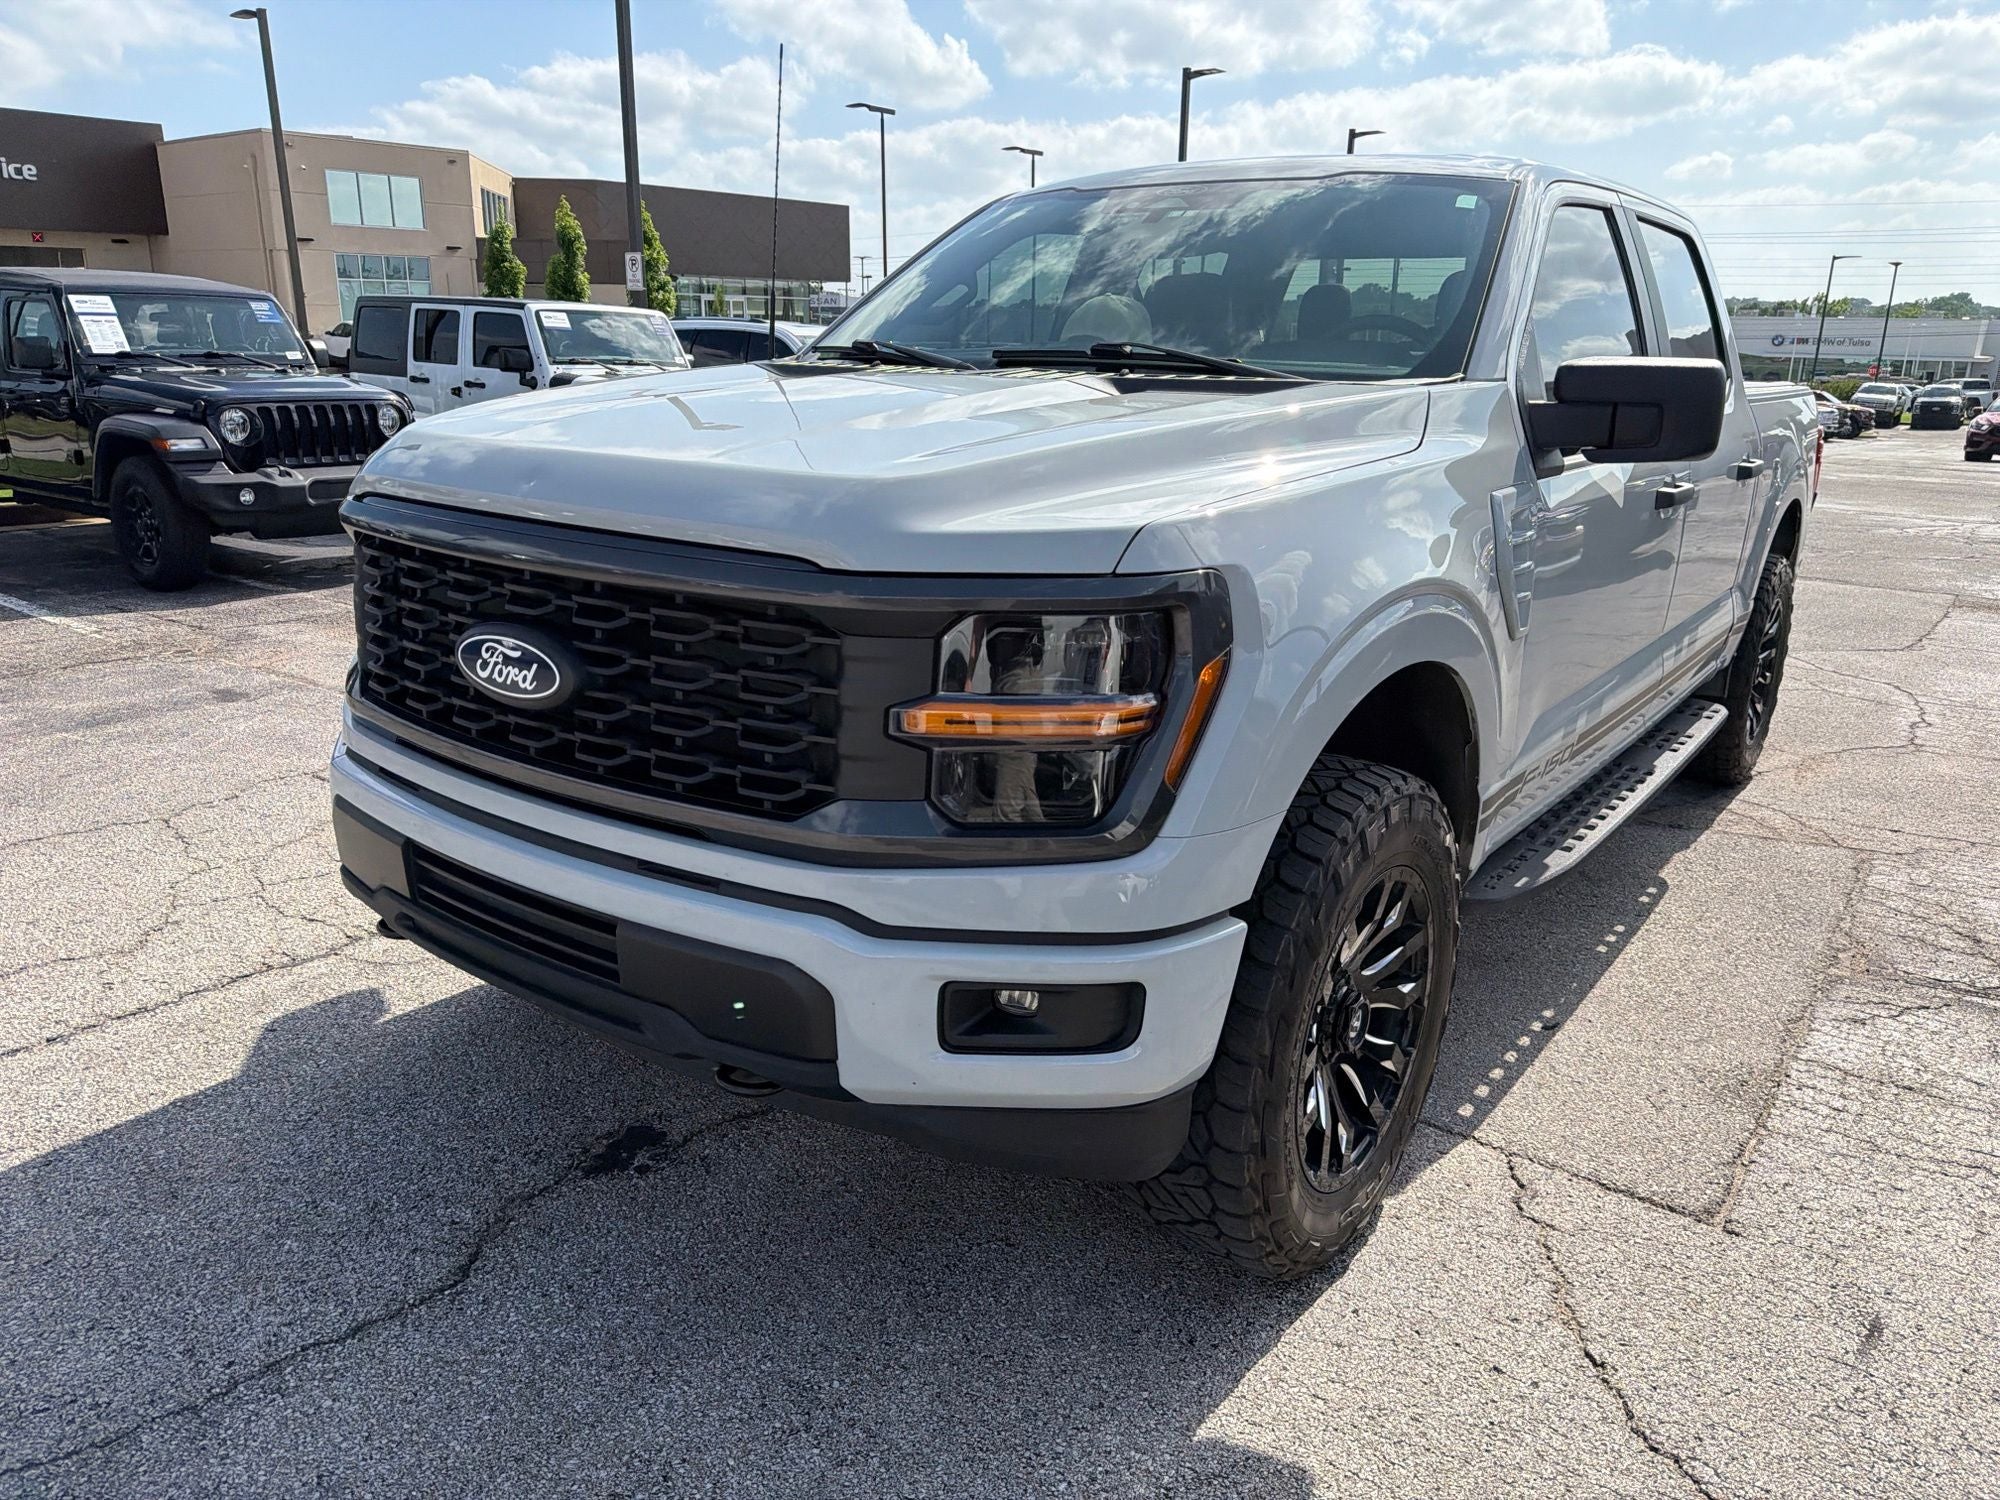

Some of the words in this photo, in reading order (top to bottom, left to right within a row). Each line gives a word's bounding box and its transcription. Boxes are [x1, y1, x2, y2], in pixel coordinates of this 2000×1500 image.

[1836, 337, 1847, 346] of
[1847, 337, 1872, 347] Tulsa
[476, 642, 538, 691] Ford
[1519, 742, 1575, 794] F-150
